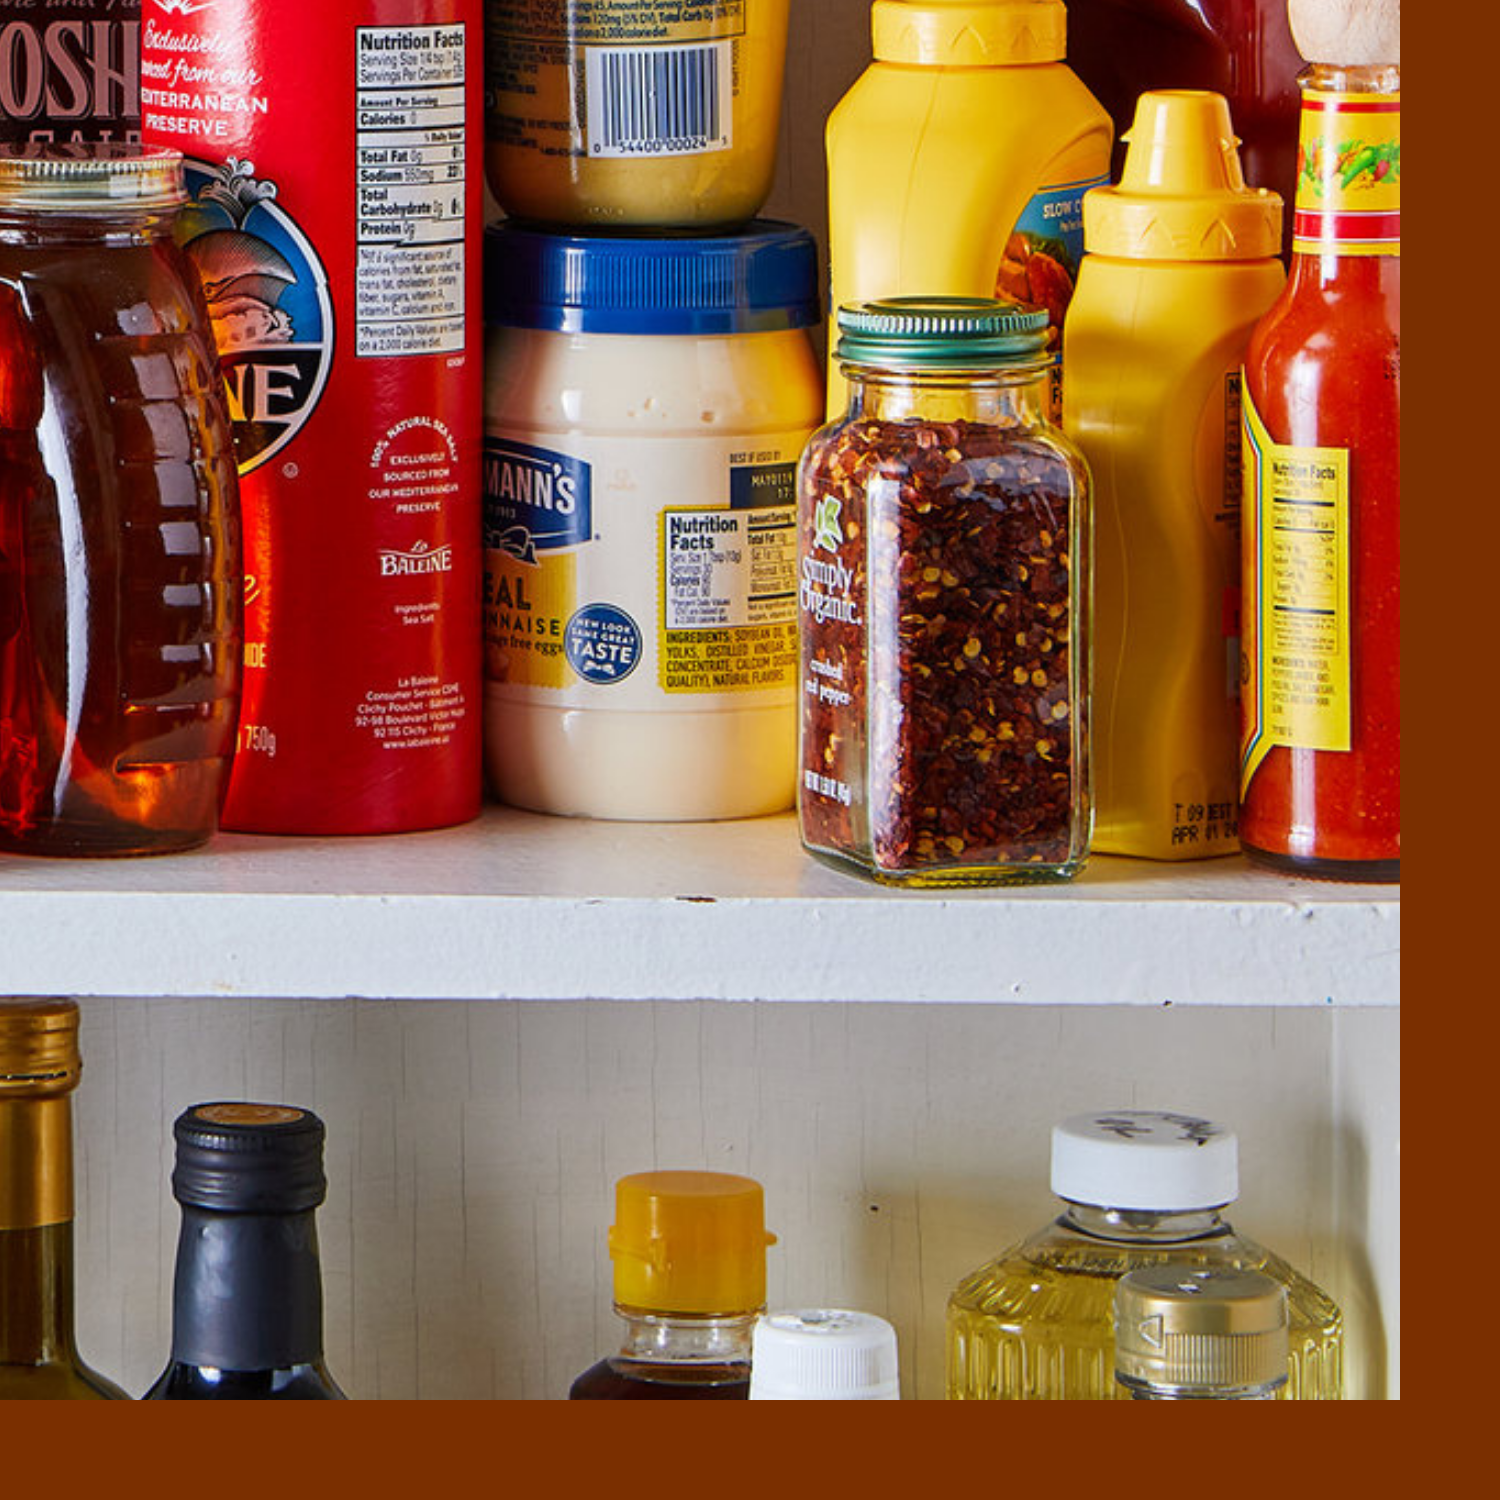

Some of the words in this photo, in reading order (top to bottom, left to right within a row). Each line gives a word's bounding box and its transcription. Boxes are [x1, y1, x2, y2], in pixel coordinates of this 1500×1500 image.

[361, 32, 430, 50] Nutrition
[434, 31, 463, 45] Facts
[146, 113, 228, 136] PRESERVE
[361, 112, 405, 125] Calories
[670, 516, 738, 534] Nutrition
[670, 535, 714, 551] Facts
[380, 550, 452, 576] BALEINE
[802, 556, 853, 597] Simply
[571, 638, 632, 664] TASTE
